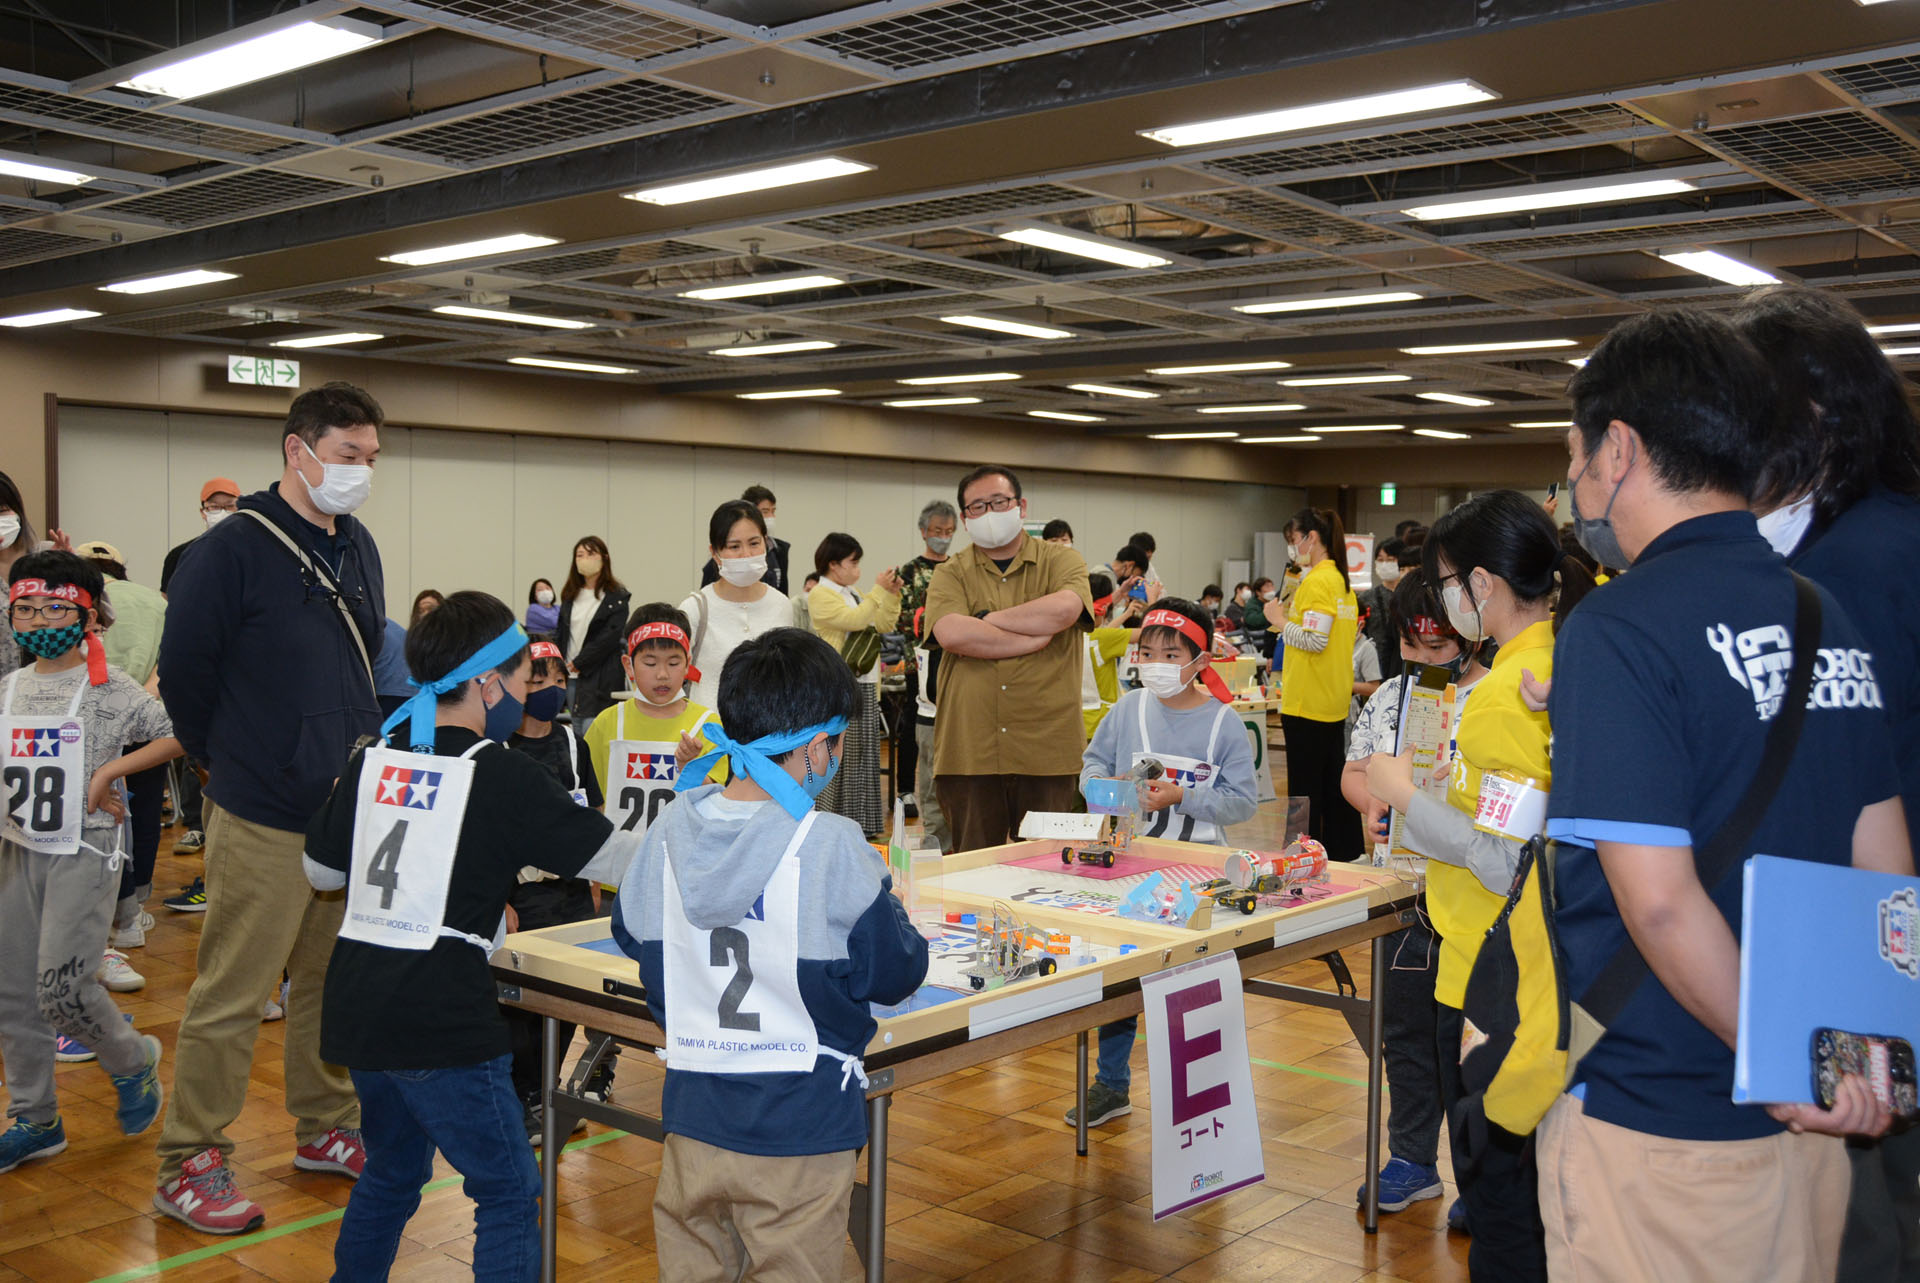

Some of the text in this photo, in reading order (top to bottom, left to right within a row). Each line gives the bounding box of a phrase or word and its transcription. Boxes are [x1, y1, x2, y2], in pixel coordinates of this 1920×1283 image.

[4, 766, 66, 832] 28
[366, 819, 409, 910] 4
[386, 919, 414, 931] MODEL
[415, 924, 431, 934] CO.
[709, 926, 761, 1032] 2
[676, 1037, 808, 1053] TAMIYA PLASTIC MODEL CO.
[1165, 978, 1232, 1127] E
[1180, 1116, 1225, 1150] コート
[326, 1140, 356, 1164] N
[175, 1188, 203, 1216] N
